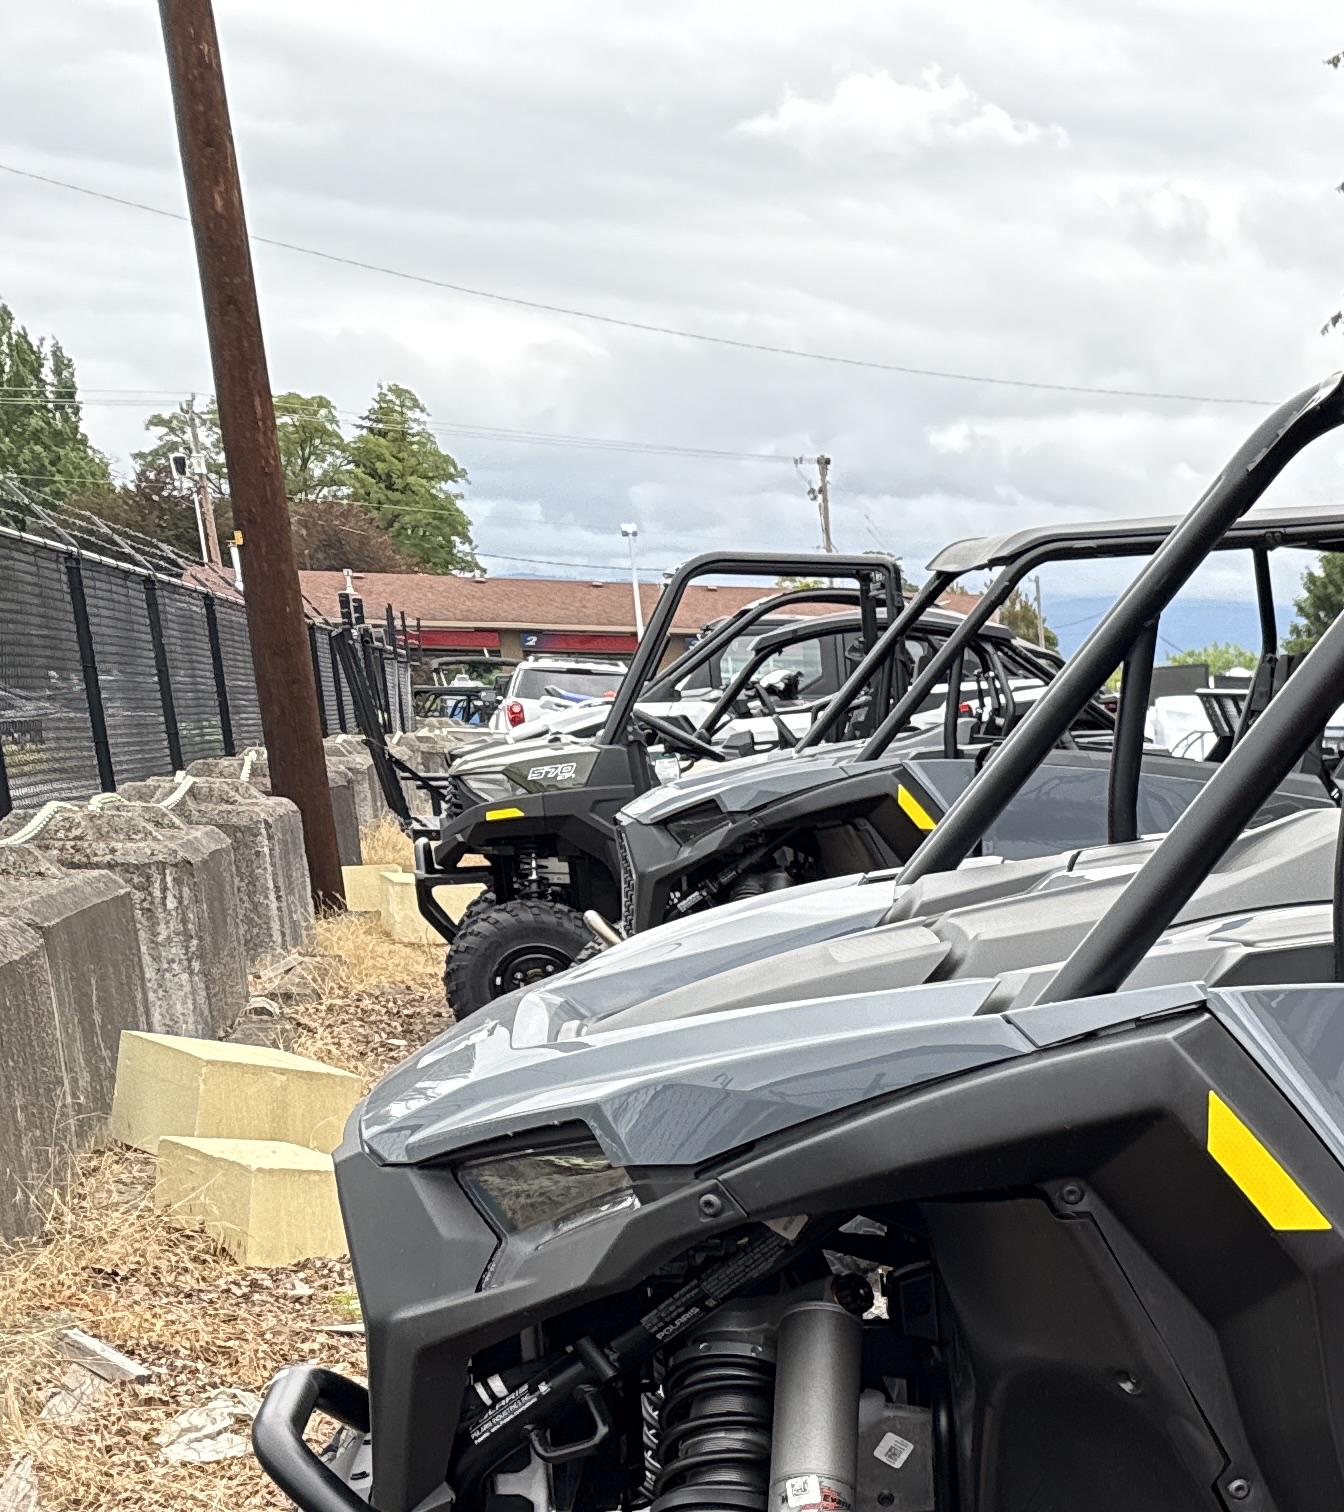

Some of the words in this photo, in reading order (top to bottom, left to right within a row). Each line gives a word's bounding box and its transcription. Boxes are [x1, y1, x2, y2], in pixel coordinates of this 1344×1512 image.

[524, 636, 538, 646] 2
[527, 762, 577, 781] 570
[655, 1306, 700, 1341] POLARIS
